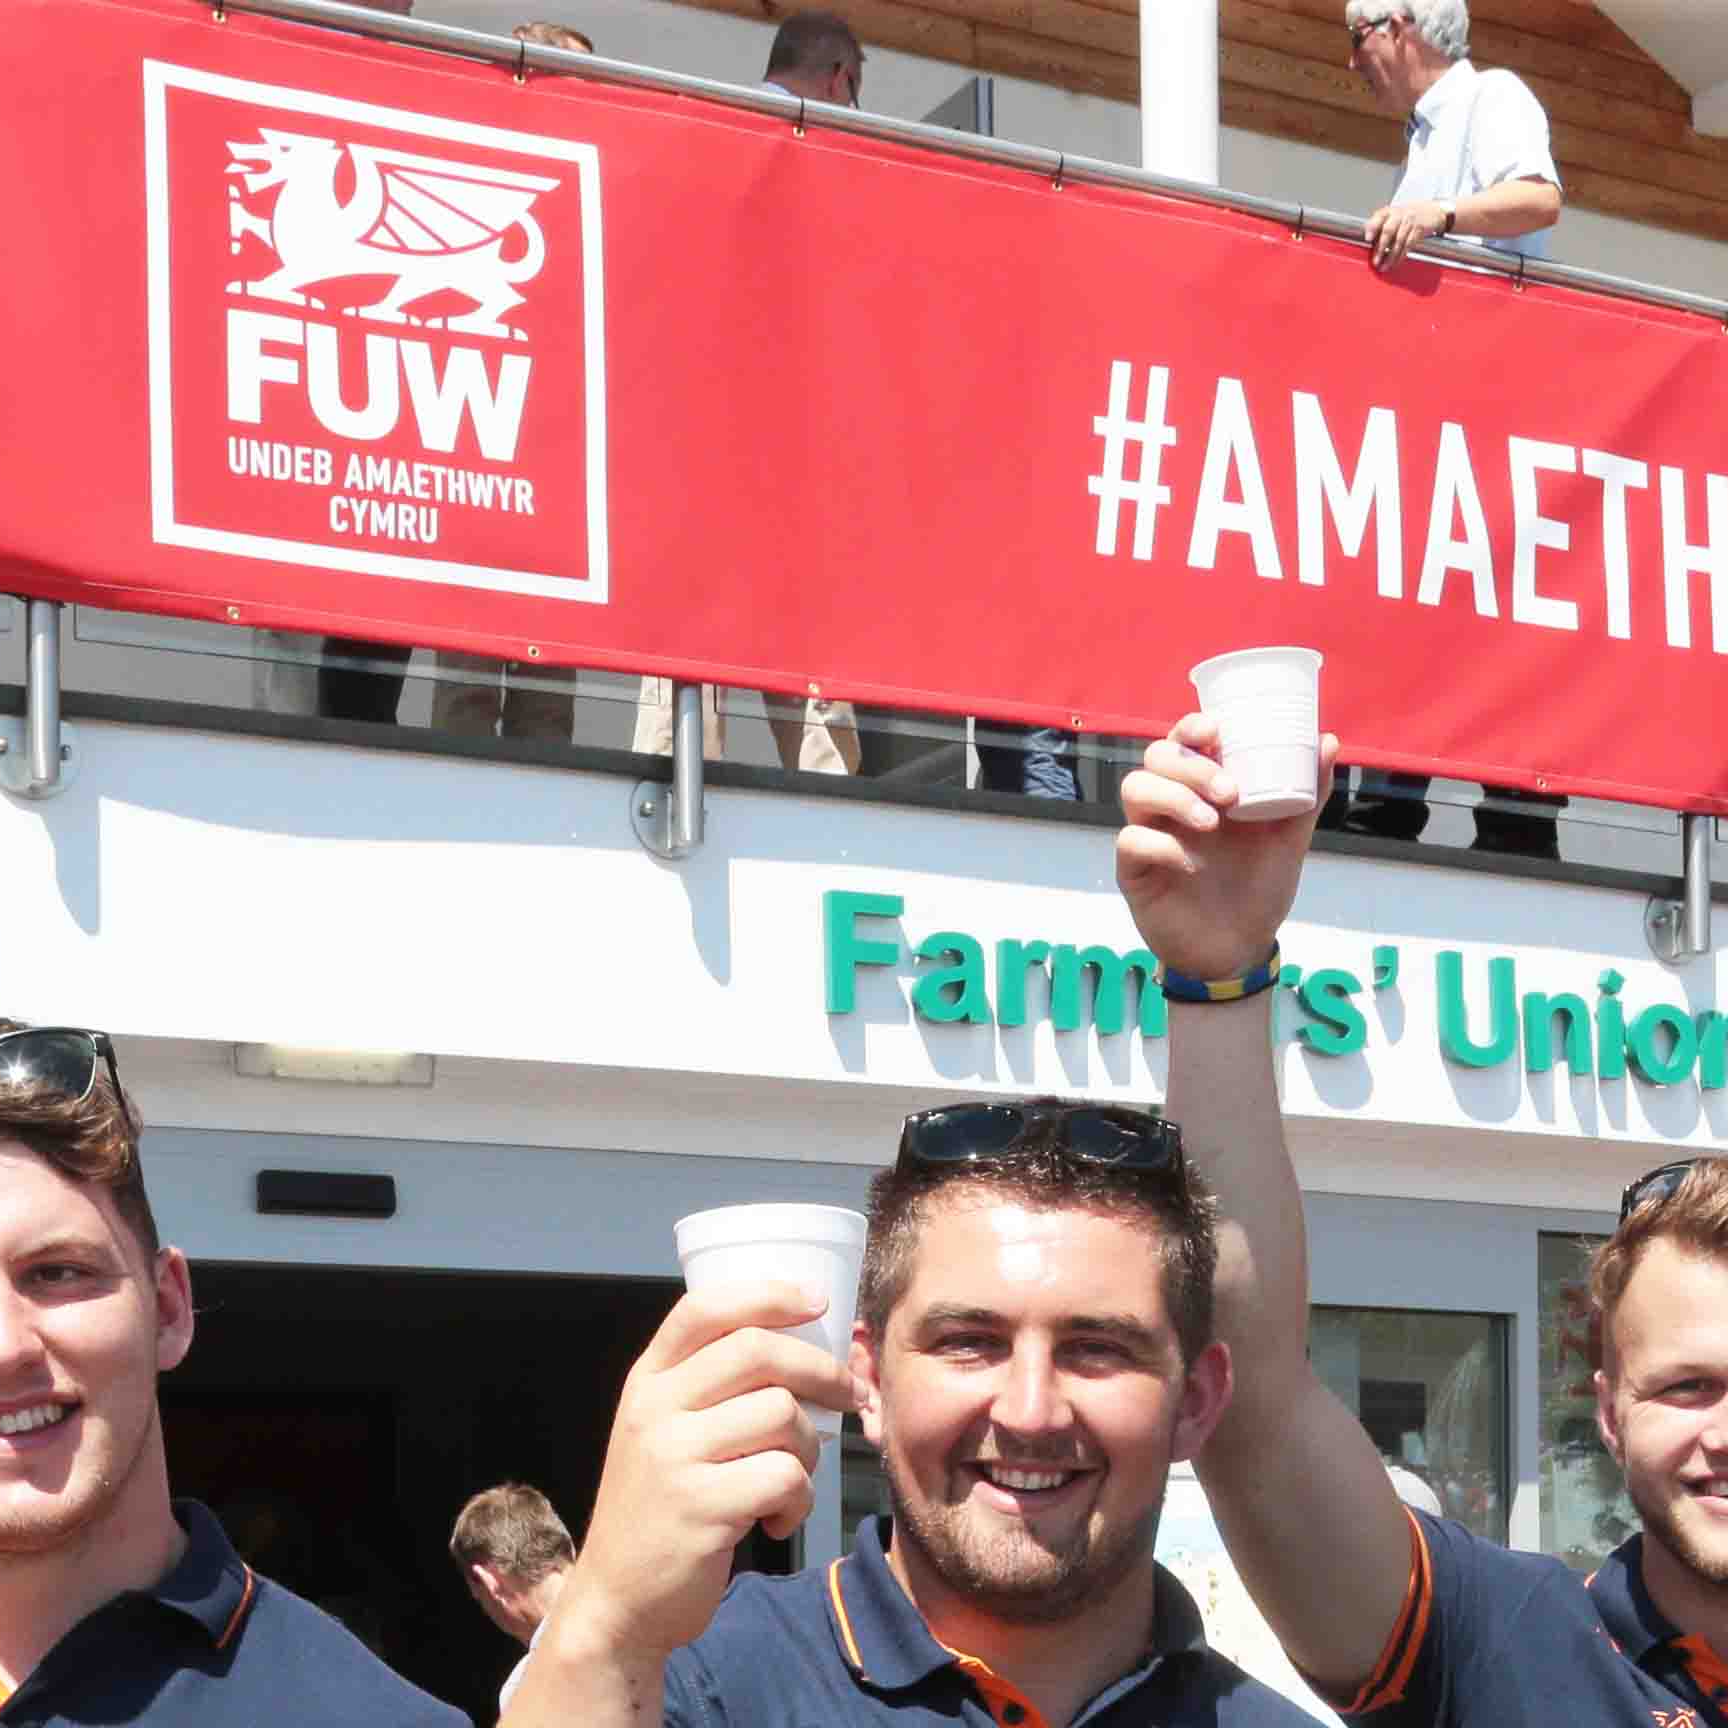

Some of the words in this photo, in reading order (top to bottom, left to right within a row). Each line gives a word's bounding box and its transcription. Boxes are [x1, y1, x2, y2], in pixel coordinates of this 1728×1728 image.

[227, 308, 532, 462] FUW
[228, 436, 333, 486] UNDEB
[344, 453, 535, 515] AMAETHWYR
[329, 493, 439, 543] CYMRU
[823, 890, 1399, 1056] Farms'
